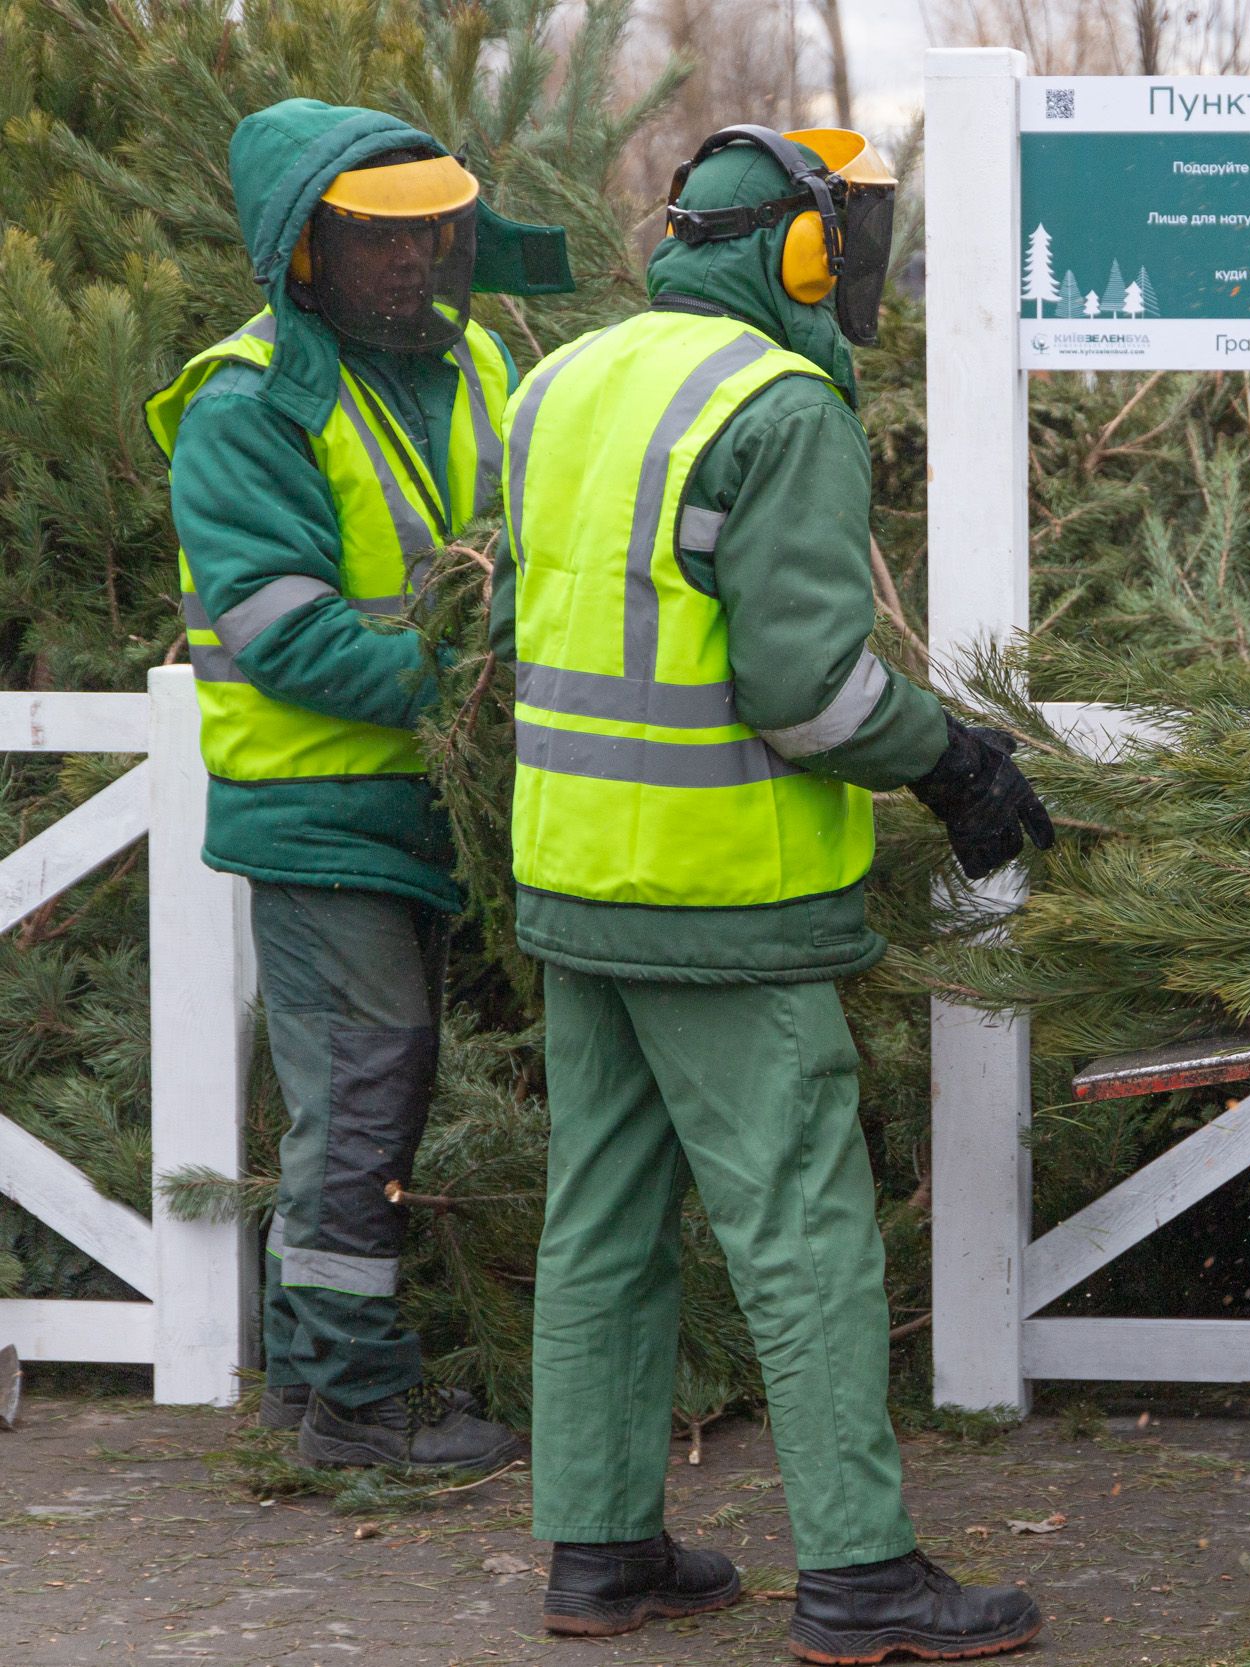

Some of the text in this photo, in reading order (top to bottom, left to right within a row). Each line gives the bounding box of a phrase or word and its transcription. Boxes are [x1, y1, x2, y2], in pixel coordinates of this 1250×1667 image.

[1172, 161, 1250, 176] Подаруйте
[1147, 211, 1189, 225] Лише
[1190, 214, 1217, 226] для
[1215, 270, 1248, 282] куди
